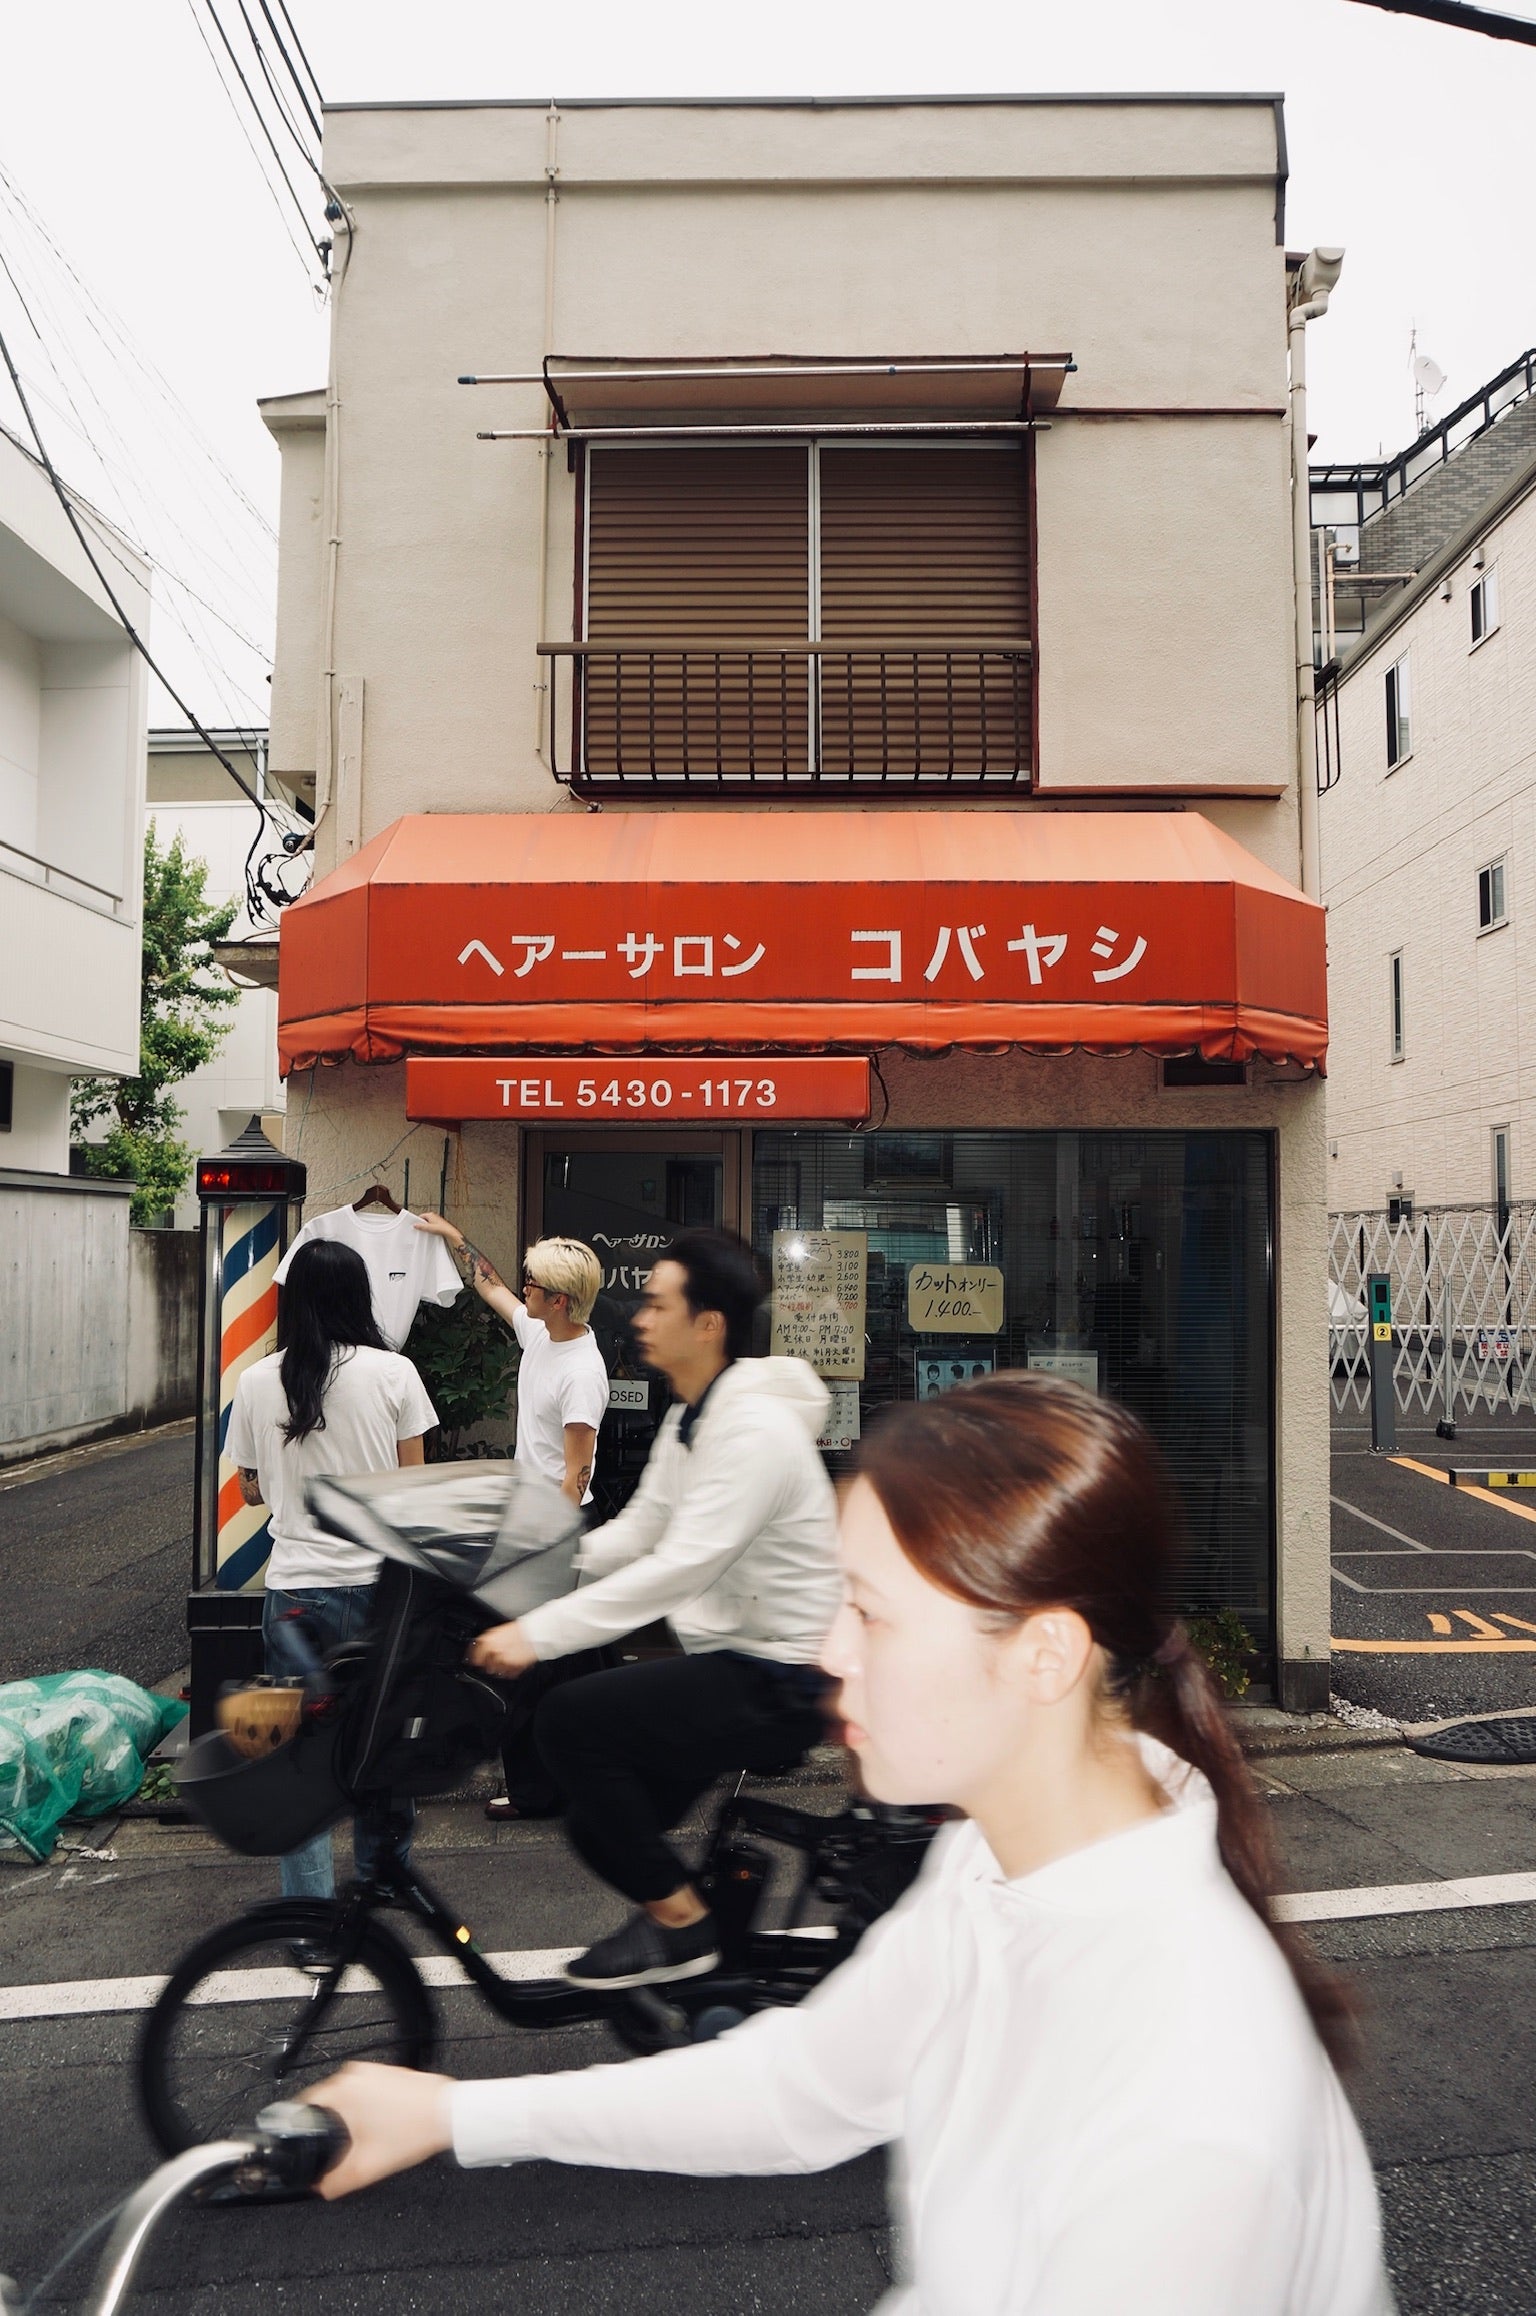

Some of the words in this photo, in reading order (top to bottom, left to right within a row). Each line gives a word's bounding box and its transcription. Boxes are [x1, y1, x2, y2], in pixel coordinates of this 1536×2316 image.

[457, 932, 766, 979] ヘアーサロン
[850, 923, 1148, 985] コバヤシ
[496, 1080, 563, 1107] TEL
[592, 1233, 674, 1248] ヘアーサロン
[600, 1266, 653, 1289] バヤ
[783, 1334, 811, 1344] 定休日
[819, 1334, 847, 1344] 月曜日
[610, 1390, 643, 1402] OSED
